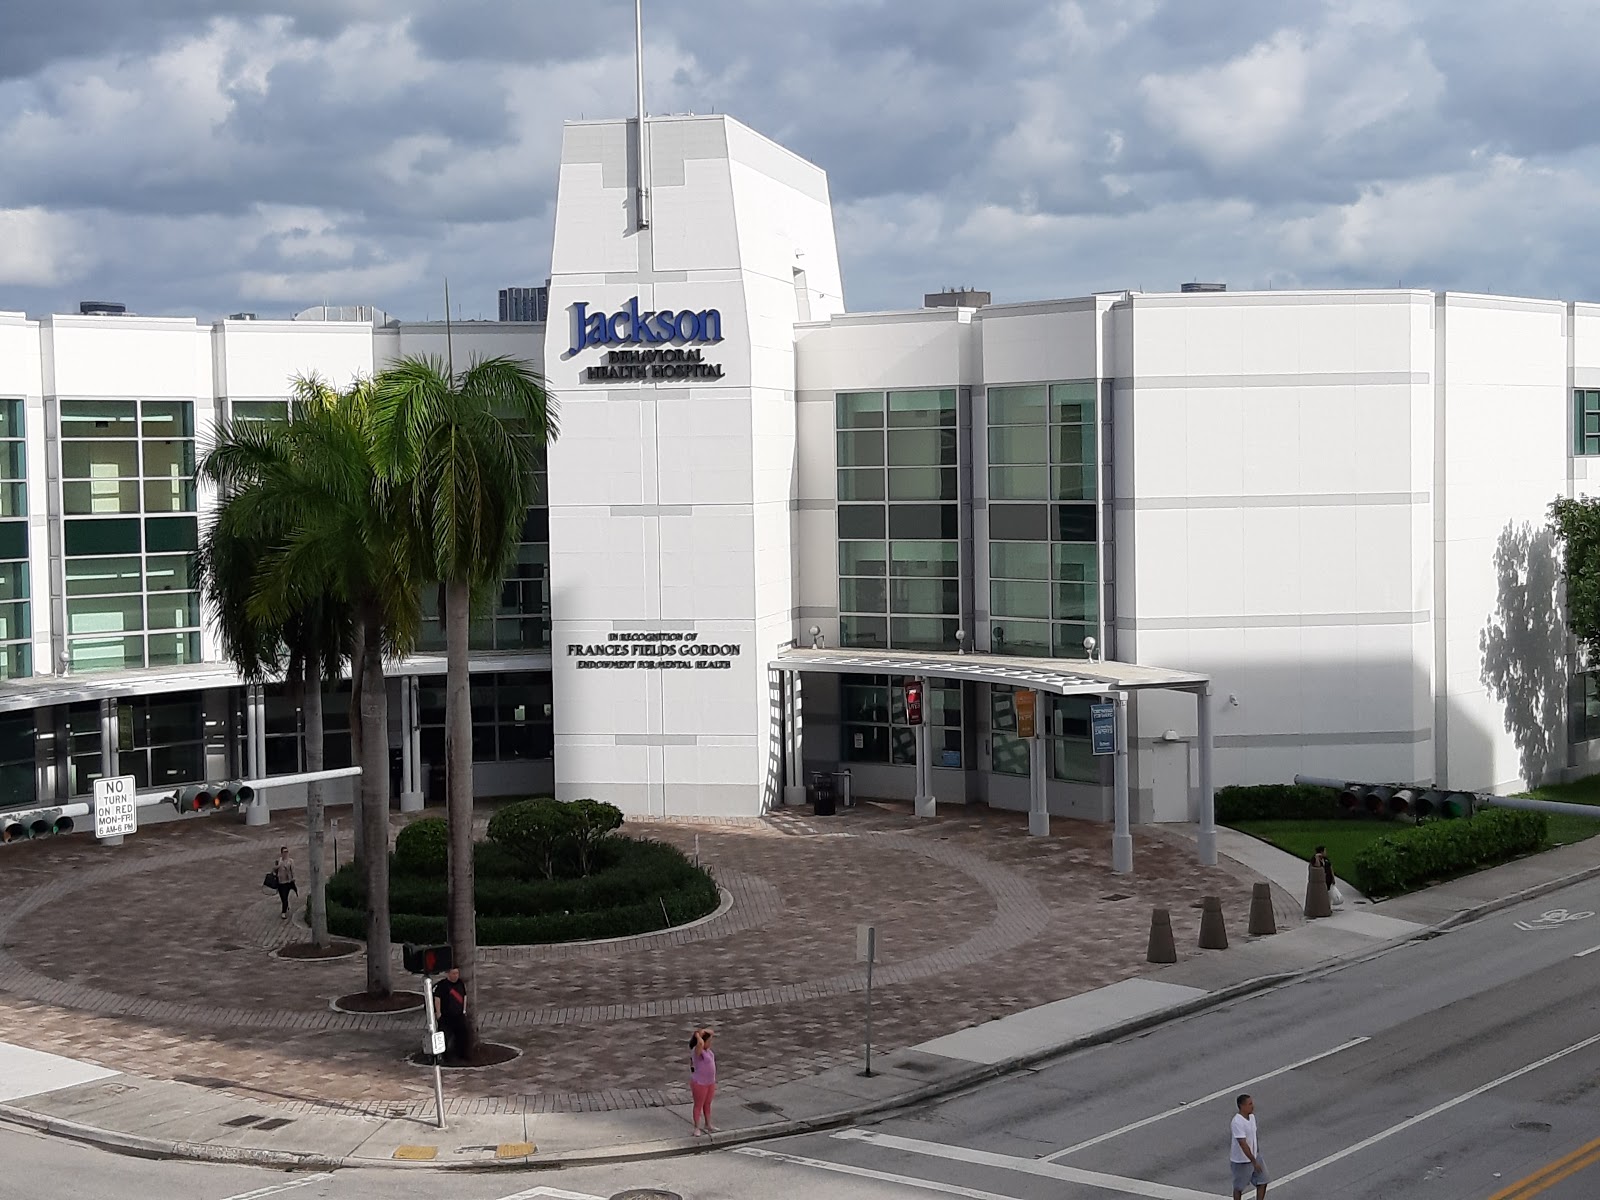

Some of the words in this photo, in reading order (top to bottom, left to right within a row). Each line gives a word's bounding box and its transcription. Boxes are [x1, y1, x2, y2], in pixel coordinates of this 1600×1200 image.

[569, 296, 725, 355] Jackson
[607, 349, 705, 364] BEHAVIORAL
[586, 366, 647, 380] HEALTH
[651, 363, 726, 378] HOSPITAL
[608, 633, 619, 642] IN
[620, 632, 684, 642] RECOGNITION
[684, 632, 698, 642] OF
[567, 644, 630, 657] FRANCES
[631, 644, 677, 657] FIELDS
[678, 643, 741, 657] GORDON
[576, 660, 636, 670] ENDOWMENT
[637, 660, 655, 670] FOR
[657, 660, 693, 670] MENTAL
[694, 660, 732, 670] HEALTH
[106, 780, 124, 794] NO
[103, 794, 127, 806] TURN
[98, 806, 111, 817] ON
[115, 804, 133, 815] RED
[99, 826, 104, 835] 6
